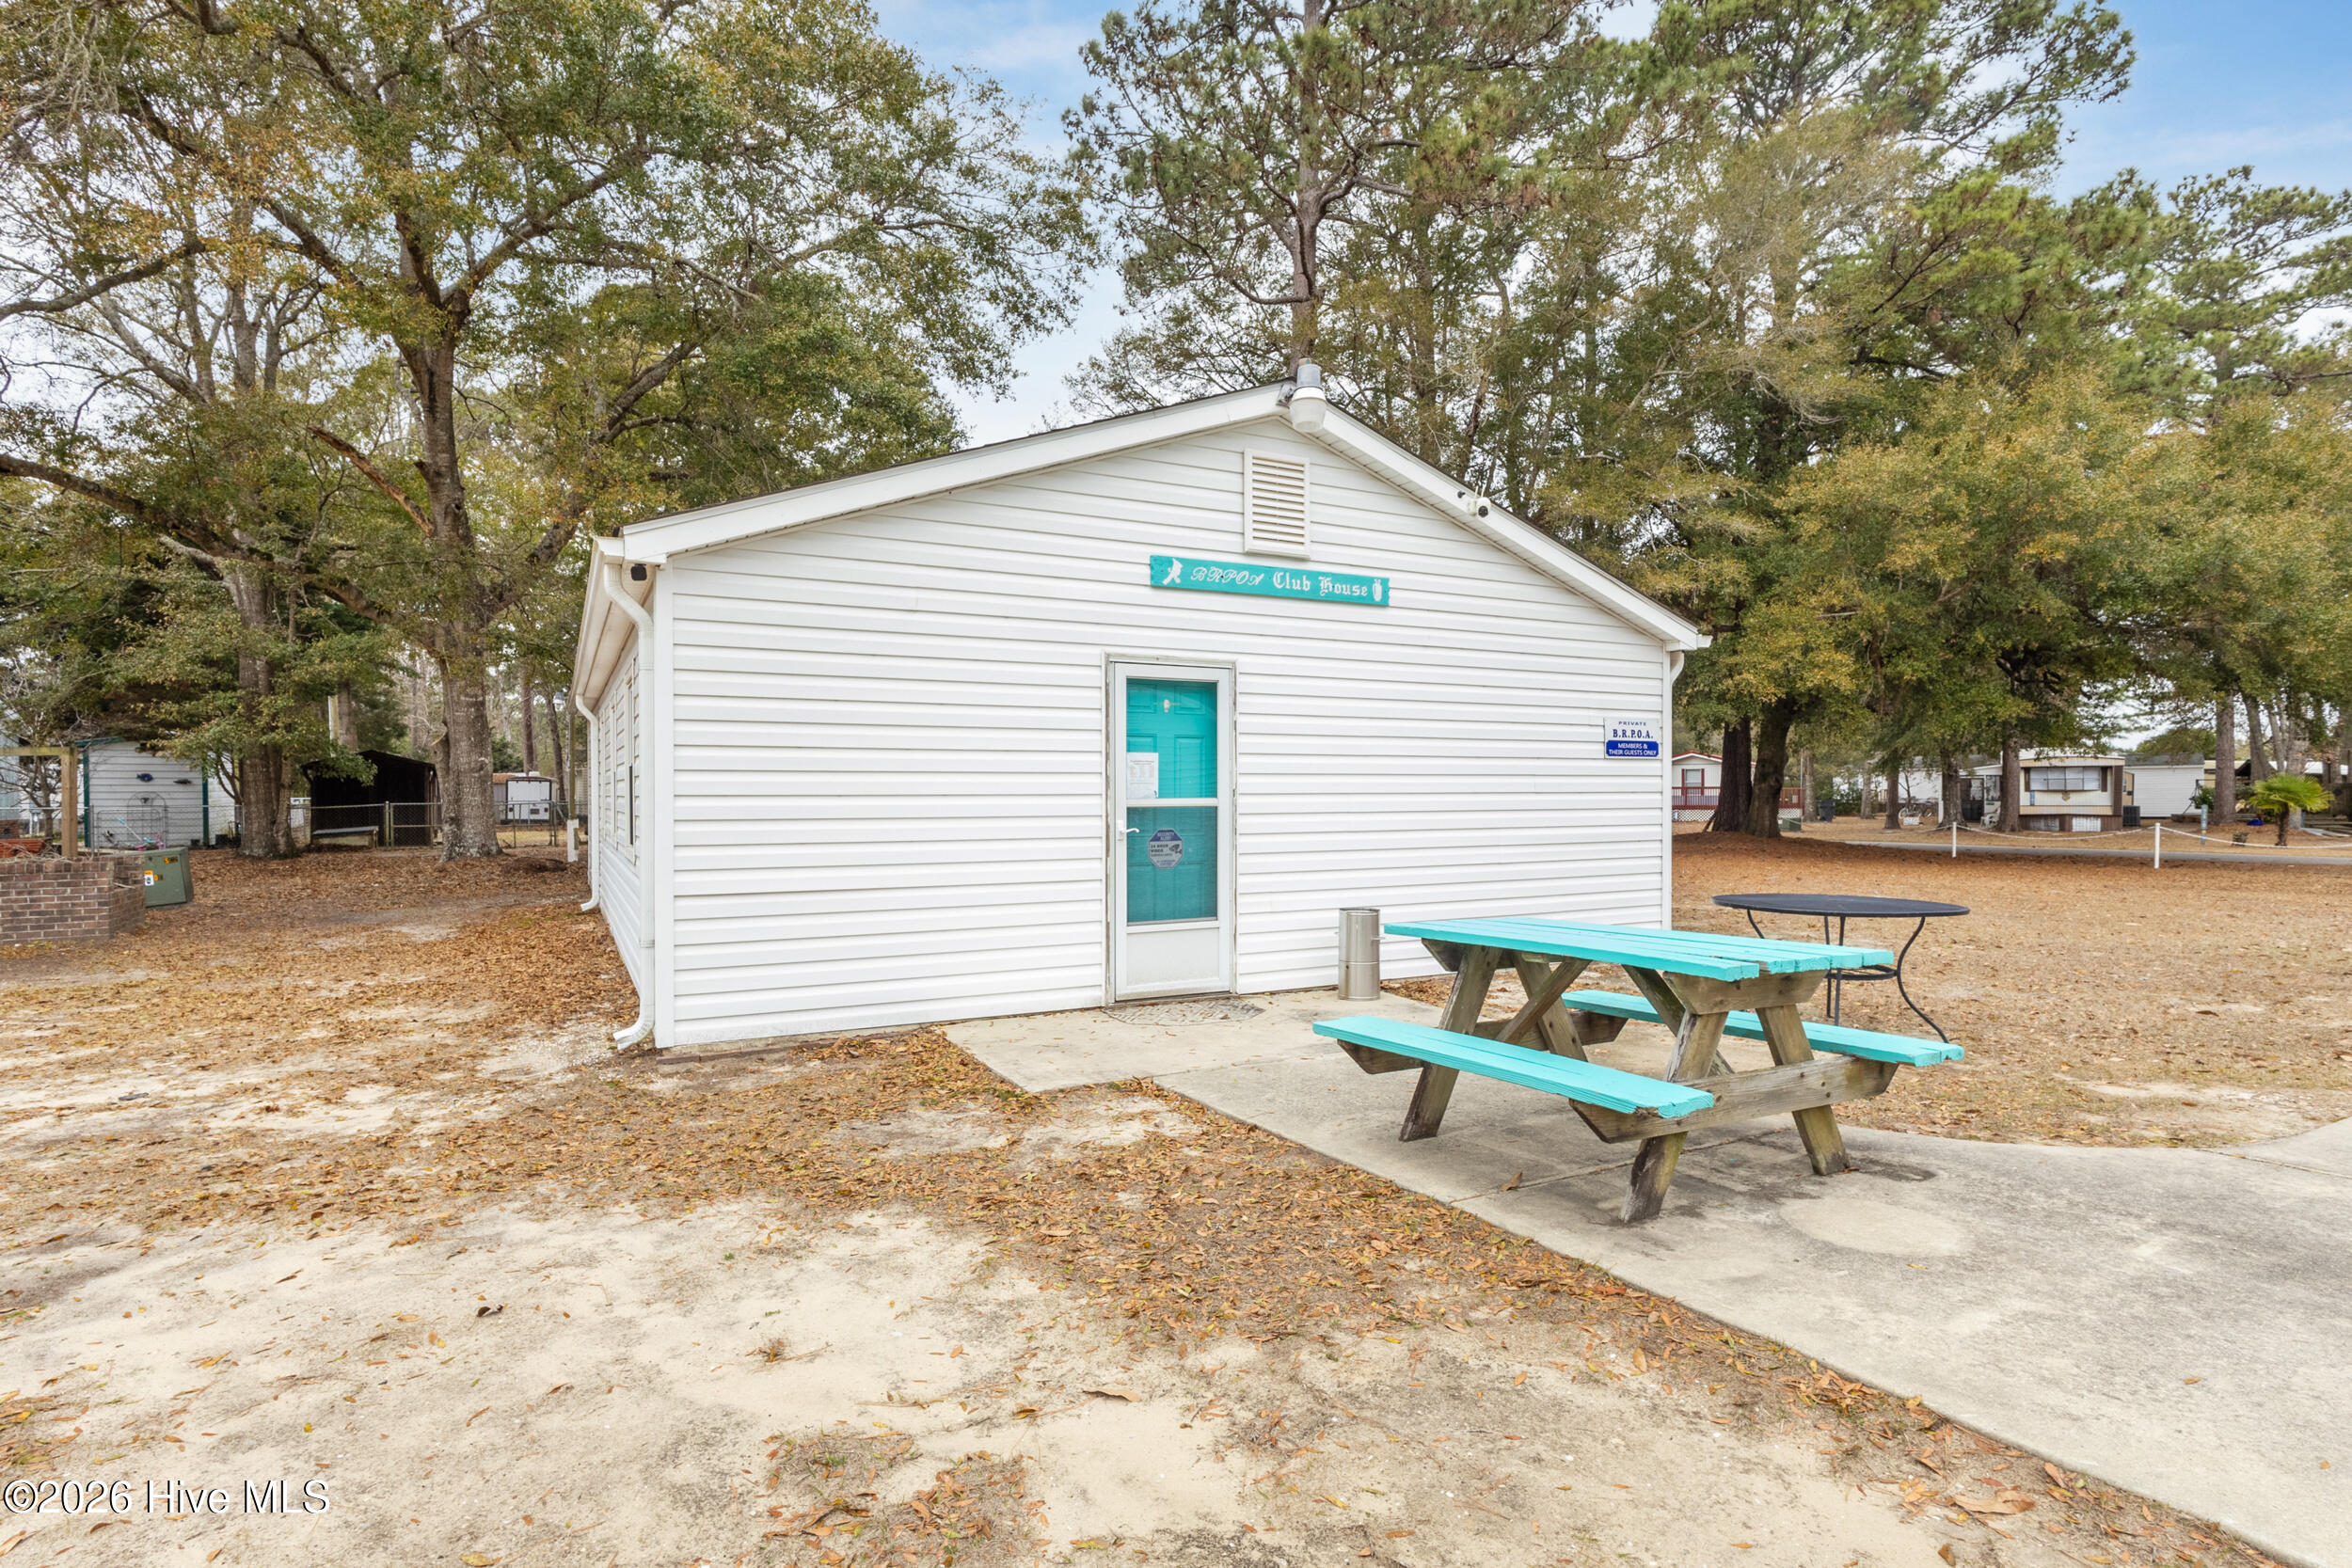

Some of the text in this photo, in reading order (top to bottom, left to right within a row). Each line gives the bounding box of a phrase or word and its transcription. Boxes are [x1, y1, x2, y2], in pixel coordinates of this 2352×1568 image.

[1273, 572, 1311, 591] Club
[1318, 576, 1368, 596] House
[1613, 729, 1653, 738] B.R.P.O.A.
